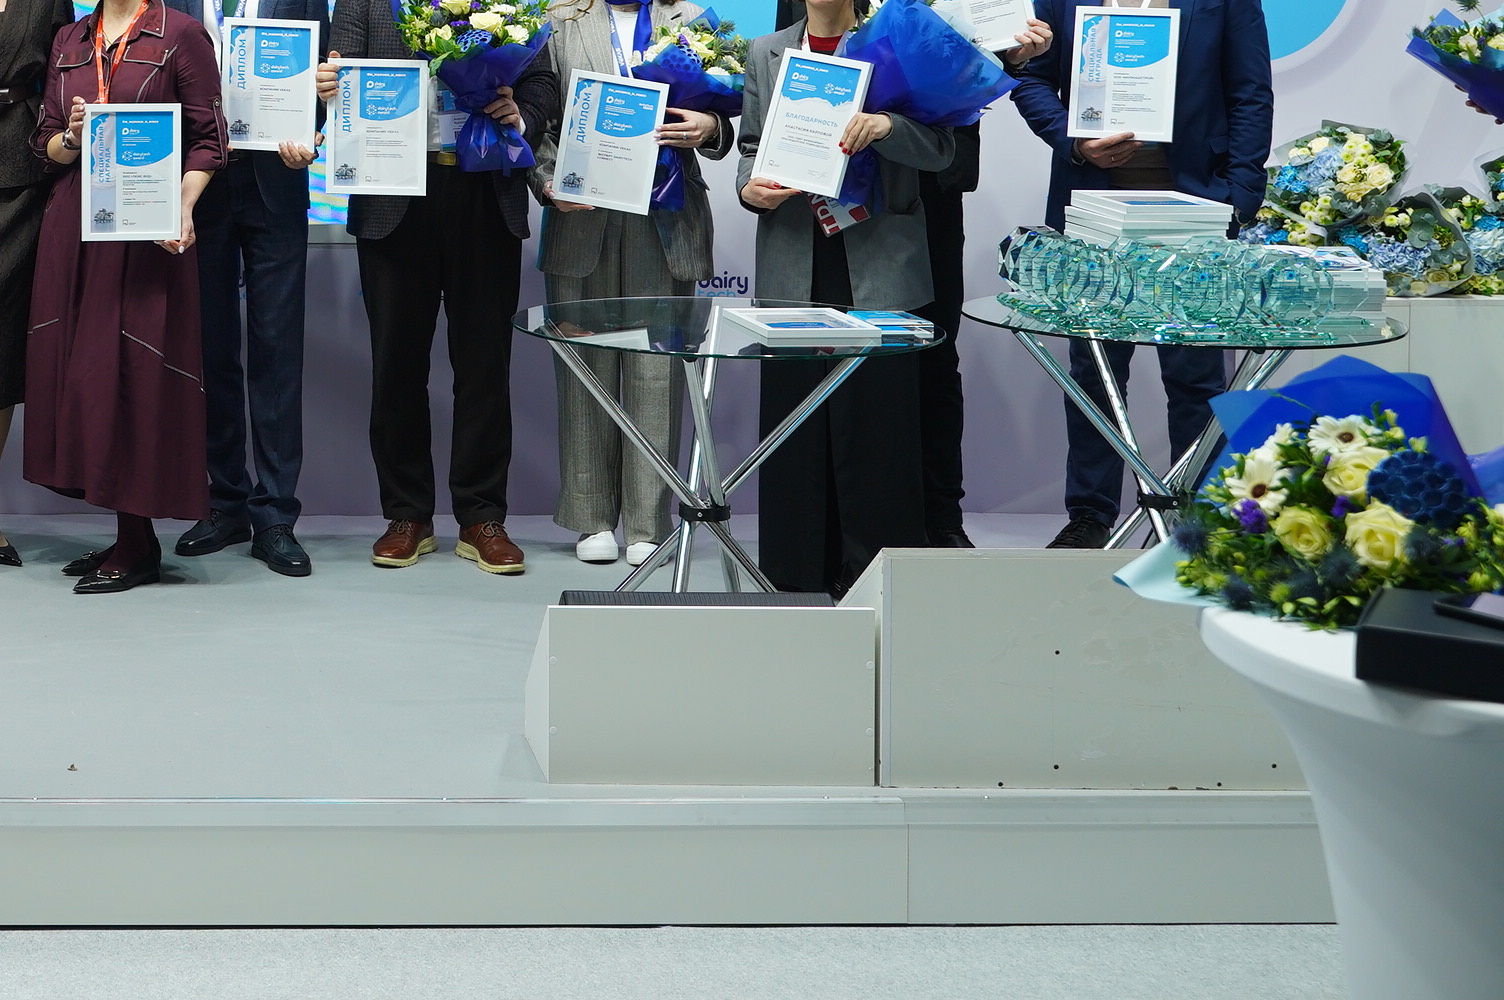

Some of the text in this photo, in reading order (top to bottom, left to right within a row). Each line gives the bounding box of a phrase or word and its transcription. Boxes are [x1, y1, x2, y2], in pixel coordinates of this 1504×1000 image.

[238, 39, 247, 89] ДИПЛОМ
[343, 80, 351, 132] ДИПЛОМ
[576, 92, 592, 143] ДИПЛОМ
[785, 112, 838, 128] БЛАГОДАРНОСТЬ
